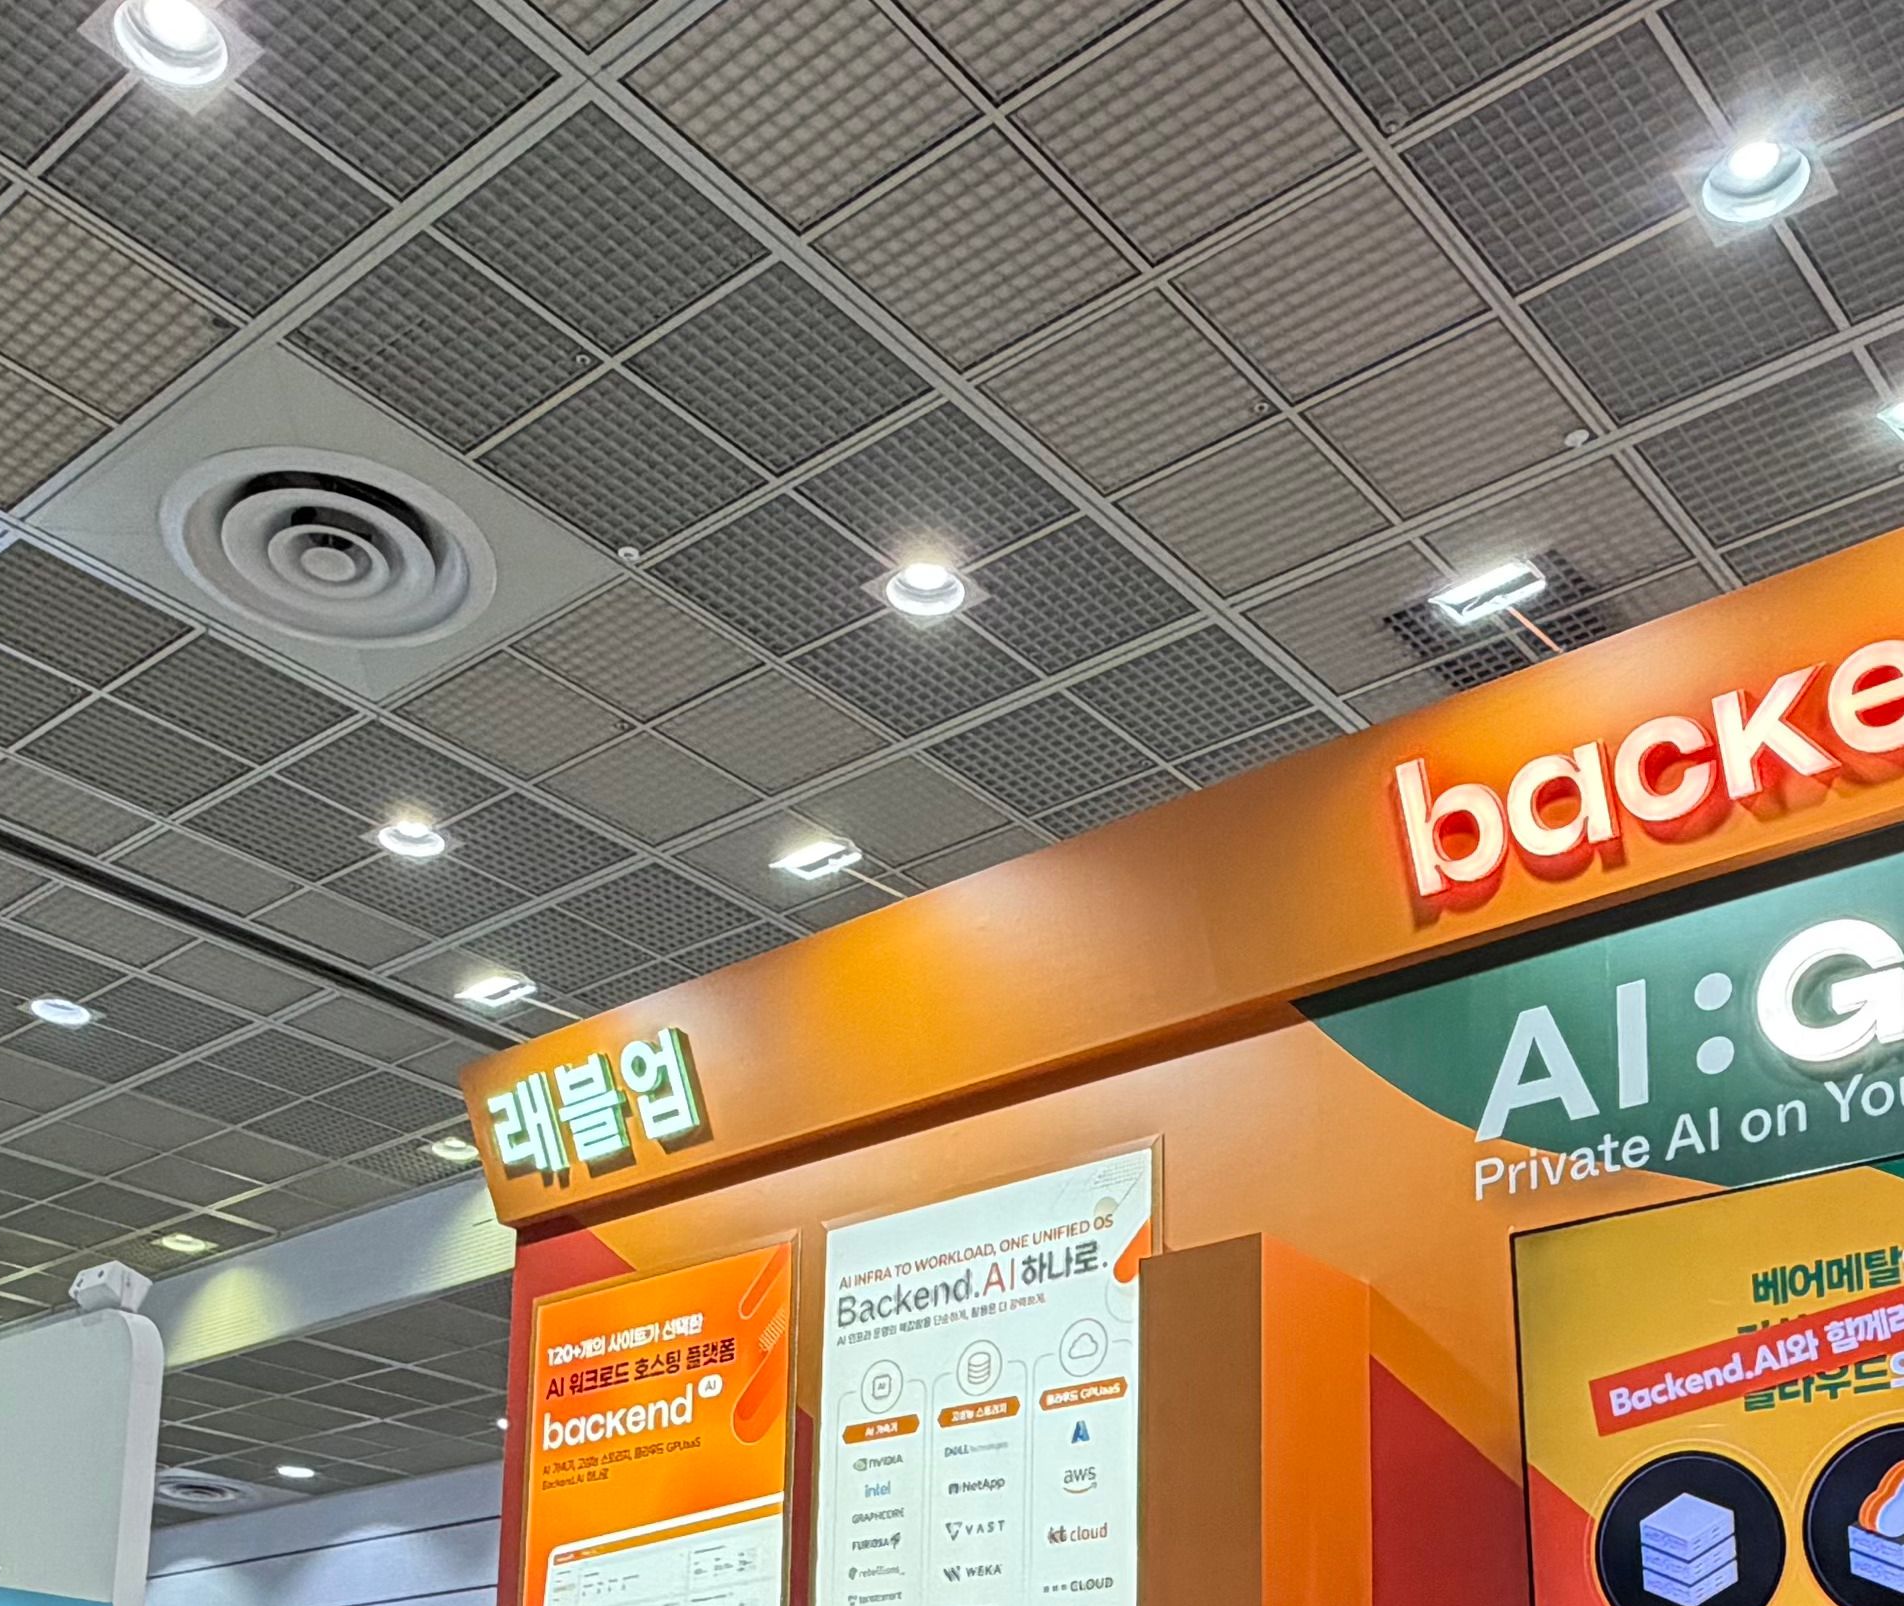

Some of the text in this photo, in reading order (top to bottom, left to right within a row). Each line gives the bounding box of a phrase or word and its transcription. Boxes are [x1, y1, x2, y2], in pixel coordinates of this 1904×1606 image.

[487, 1026, 702, 1176] 래블업
[1474, 1126, 1652, 1203] Private
[1665, 1114, 1722, 1165] AI
[1741, 1101, 1807, 1144] on
[839, 1213, 1114, 1291] AI INFRA TO WORKLOAD, ONE UNIFIED OS
[837, 1240, 1109, 1328] Backend.AI 하나로.
[546, 1337, 736, 1401] AI 워크로드 호스팅 플랫폼
[1610, 1334, 1821, 1418] Backend.AI와
[543, 1383, 693, 1451] backend
[864, 1480, 891, 1498] intel
[962, 1477, 1005, 1493] NetApp
[1063, 1466, 1097, 1484] aws
[965, 1519, 1005, 1535] VAST
[1047, 1522, 1108, 1545] kt cloud
[966, 1564, 1002, 1577] WEKA
[1069, 1577, 1114, 1592] CLOUD
